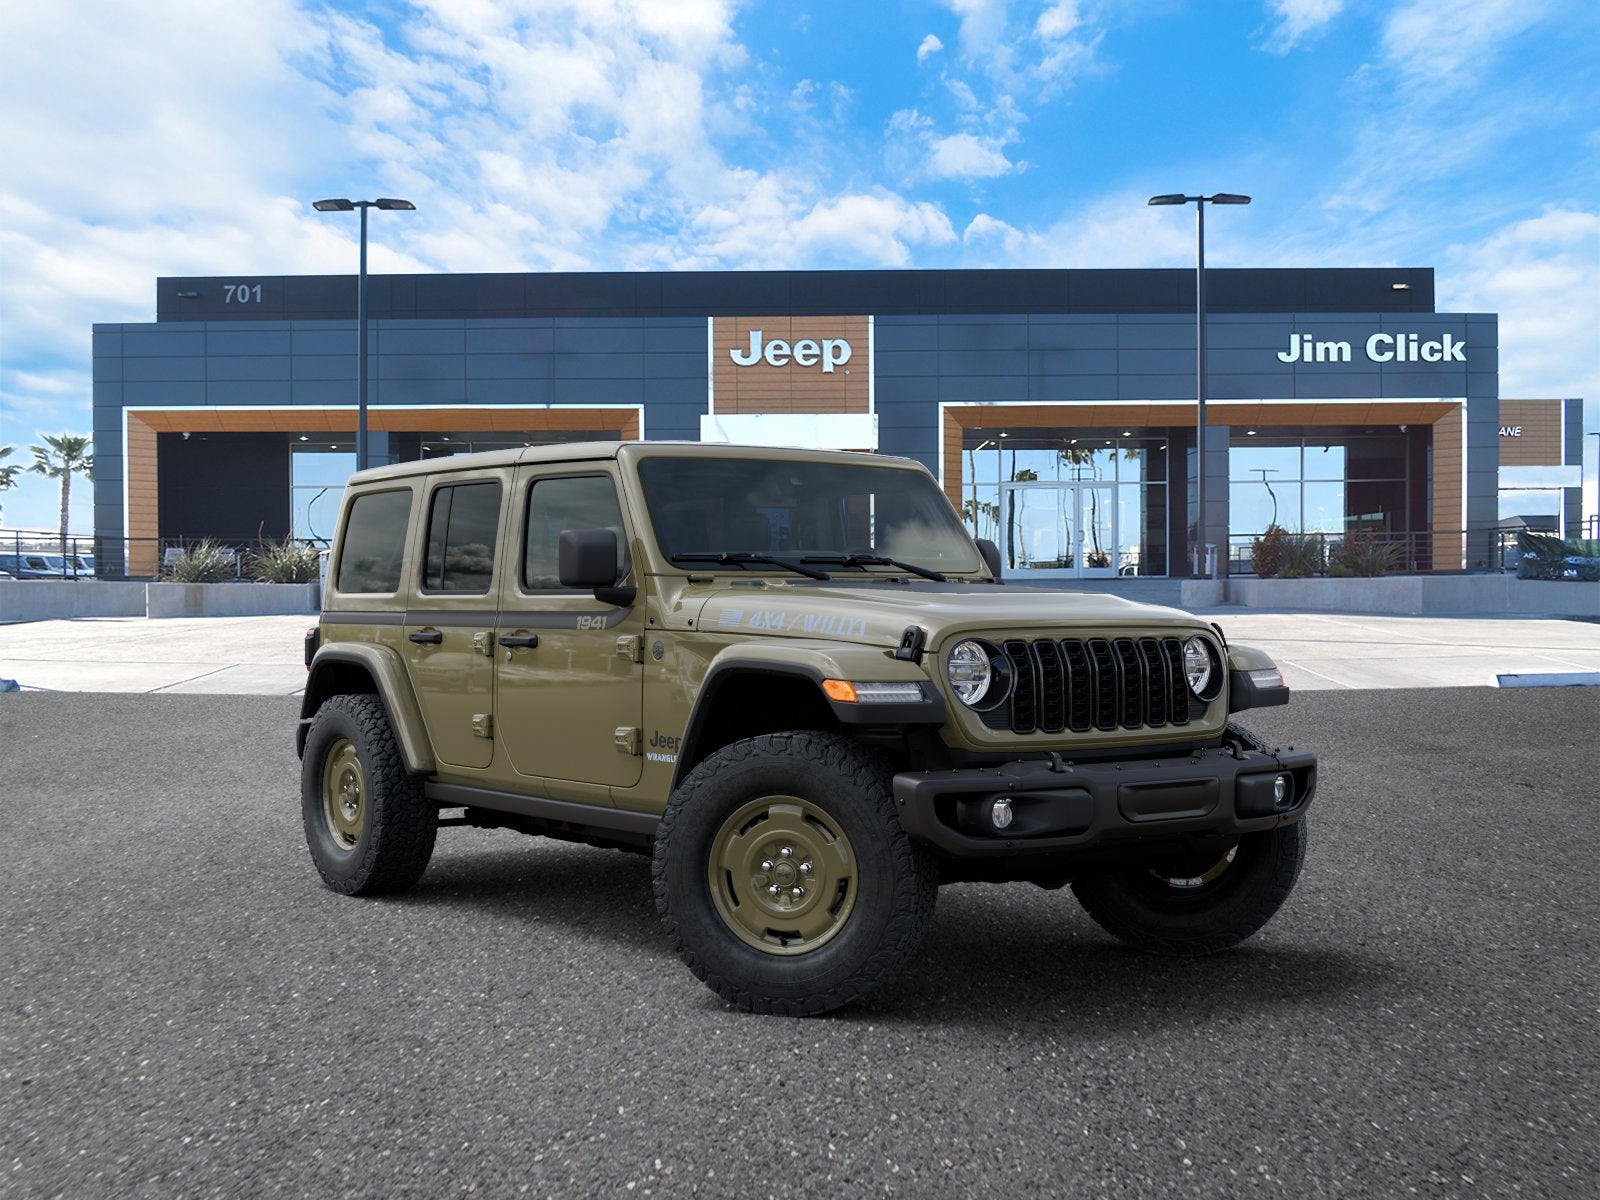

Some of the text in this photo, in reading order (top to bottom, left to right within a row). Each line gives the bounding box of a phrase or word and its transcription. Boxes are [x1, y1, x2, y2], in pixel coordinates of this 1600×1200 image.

[223, 284, 262, 303] 701
[729, 330, 852, 373] Jeep
[1277, 333, 1467, 363] Jim Click
[576, 615, 608, 630] 1941
